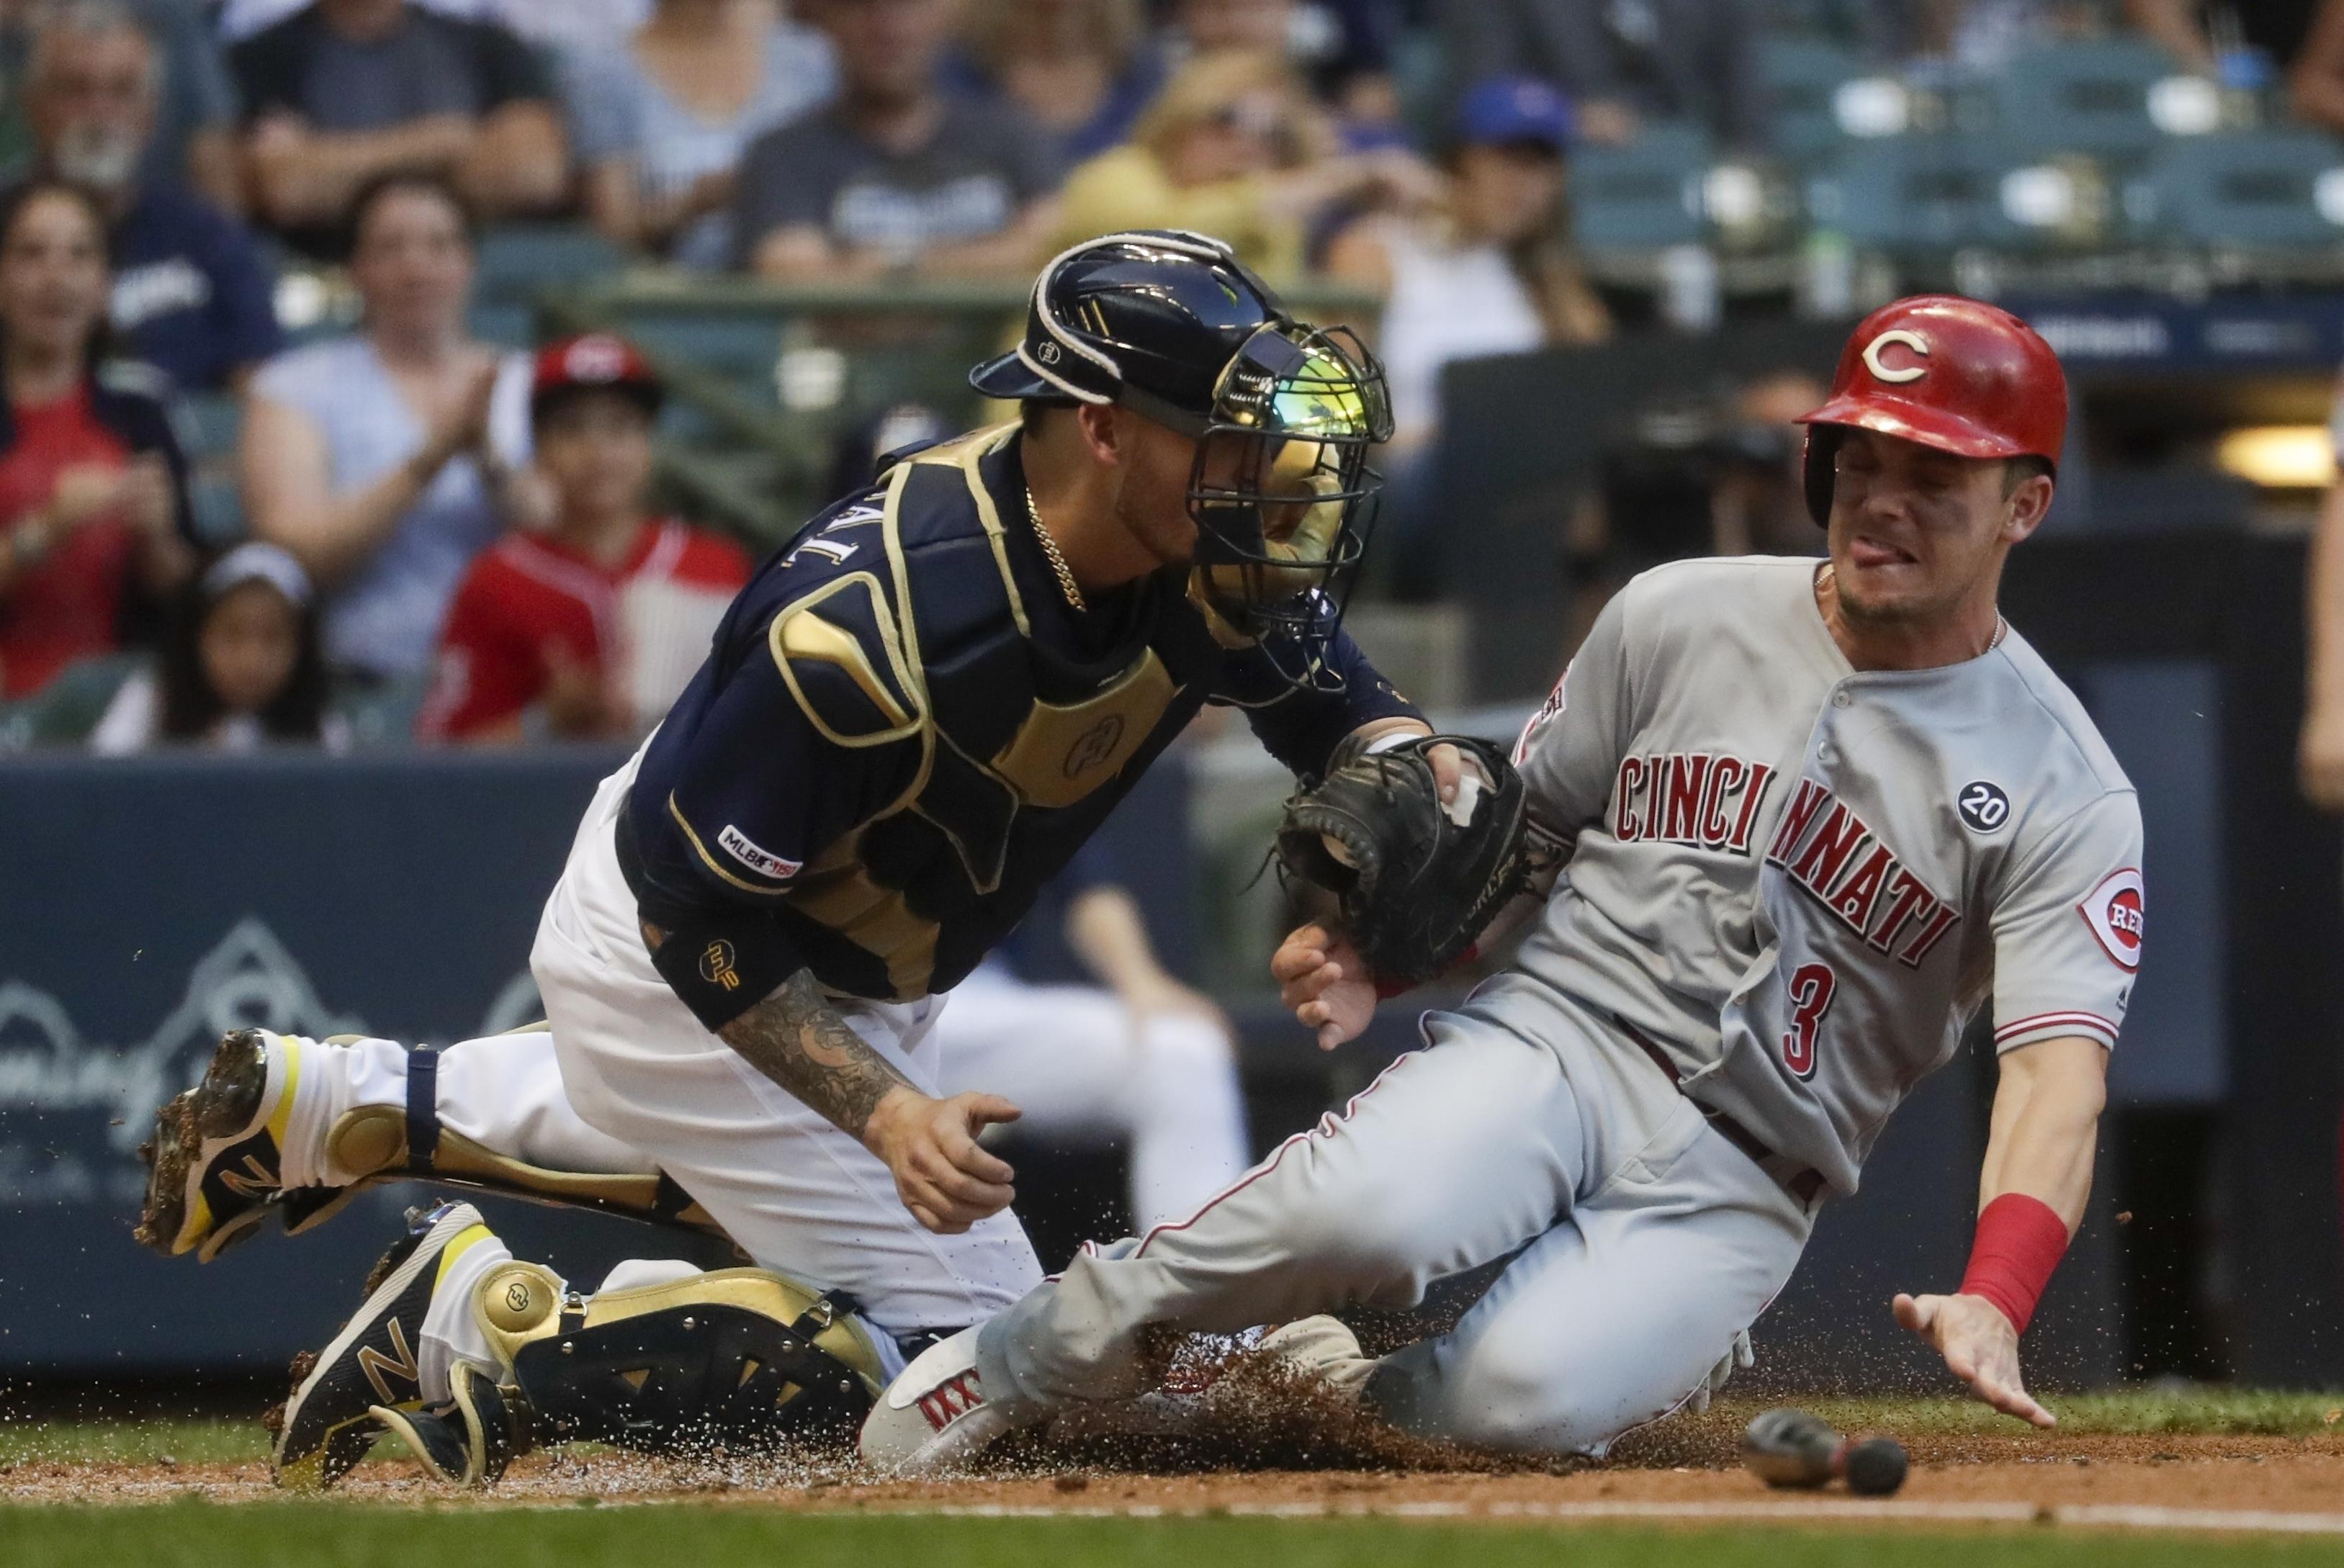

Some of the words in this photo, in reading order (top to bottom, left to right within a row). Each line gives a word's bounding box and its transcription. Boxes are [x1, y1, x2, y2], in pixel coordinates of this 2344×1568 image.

[1862, 329, 1928, 382] C
[1961, 785, 2006, 825] 20
[724, 832, 758, 862] MLB
[1783, 962, 1836, 1076] 3
